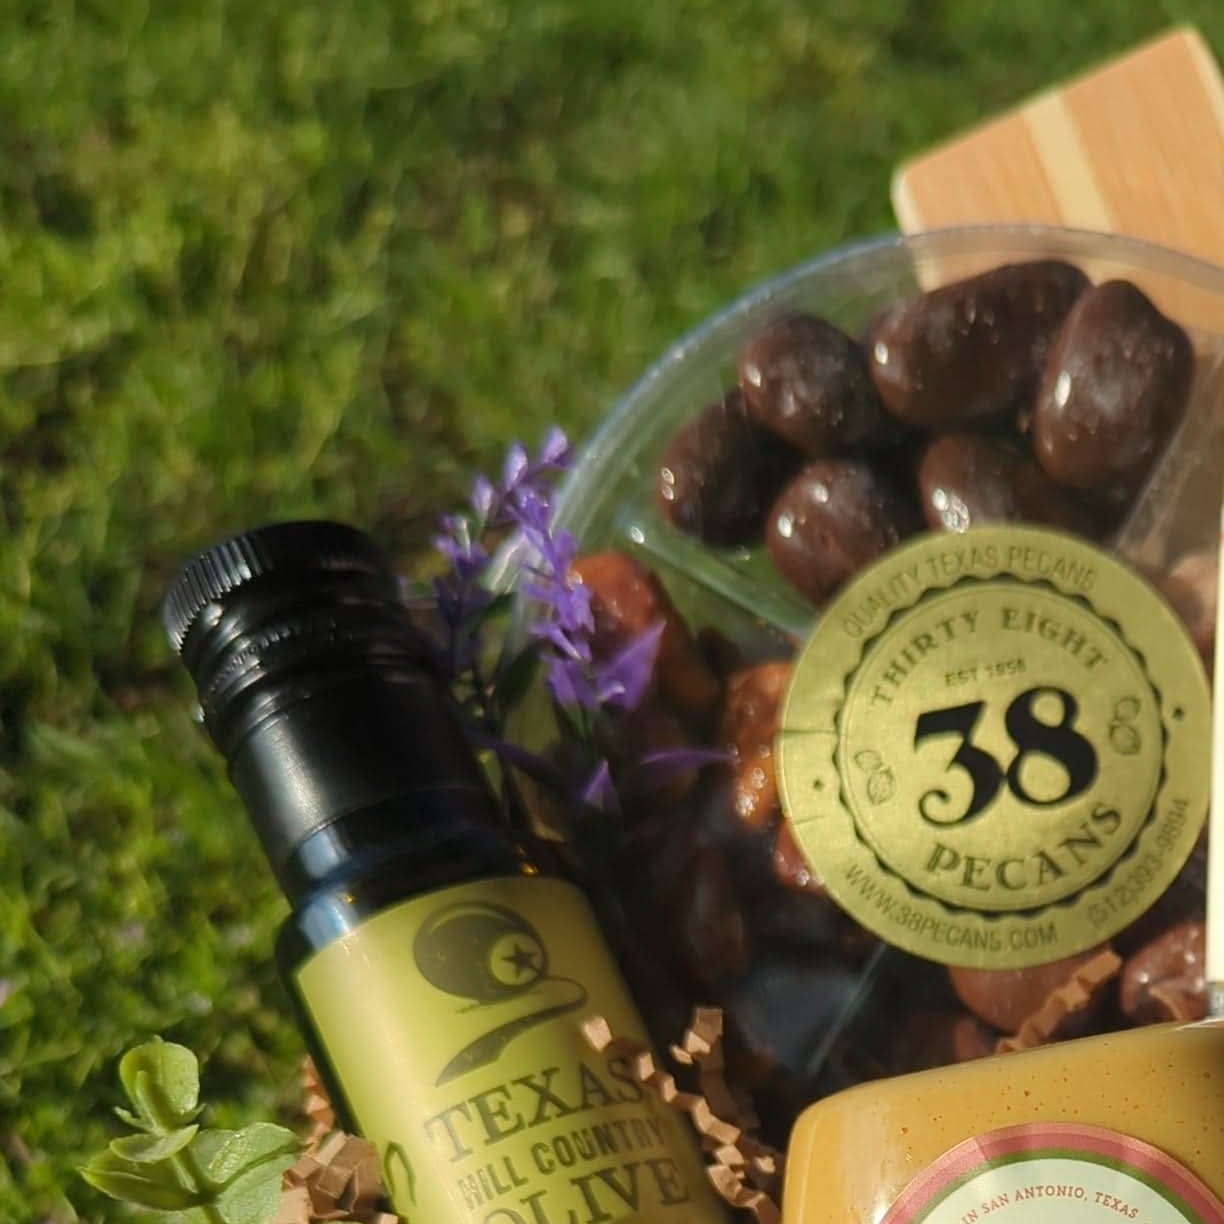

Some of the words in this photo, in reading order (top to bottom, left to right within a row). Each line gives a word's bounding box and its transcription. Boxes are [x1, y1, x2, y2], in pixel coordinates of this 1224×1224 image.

[842, 566, 921, 640] QUALITY
[927, 547, 998, 588] TEXAS
[1008, 545, 1096, 592] PECANS
[871, 609, 979, 708] THIRTY
[1001, 606, 1109, 670] EIGHT
[913, 685, 1099, 828] 38
[925, 801, 1123, 891] PECANS
[845, 863, 1059, 952] WWW.38PECANS.COM
[423, 1055, 645, 1163] TEXAS
[535, 1118, 665, 1174] COUNTRY
[982, 1193, 1009, 1214] SAN
[1014, 1185, 1088, 1201] ANTONIO,
[1094, 1191, 1139, 1219] TEXAS
